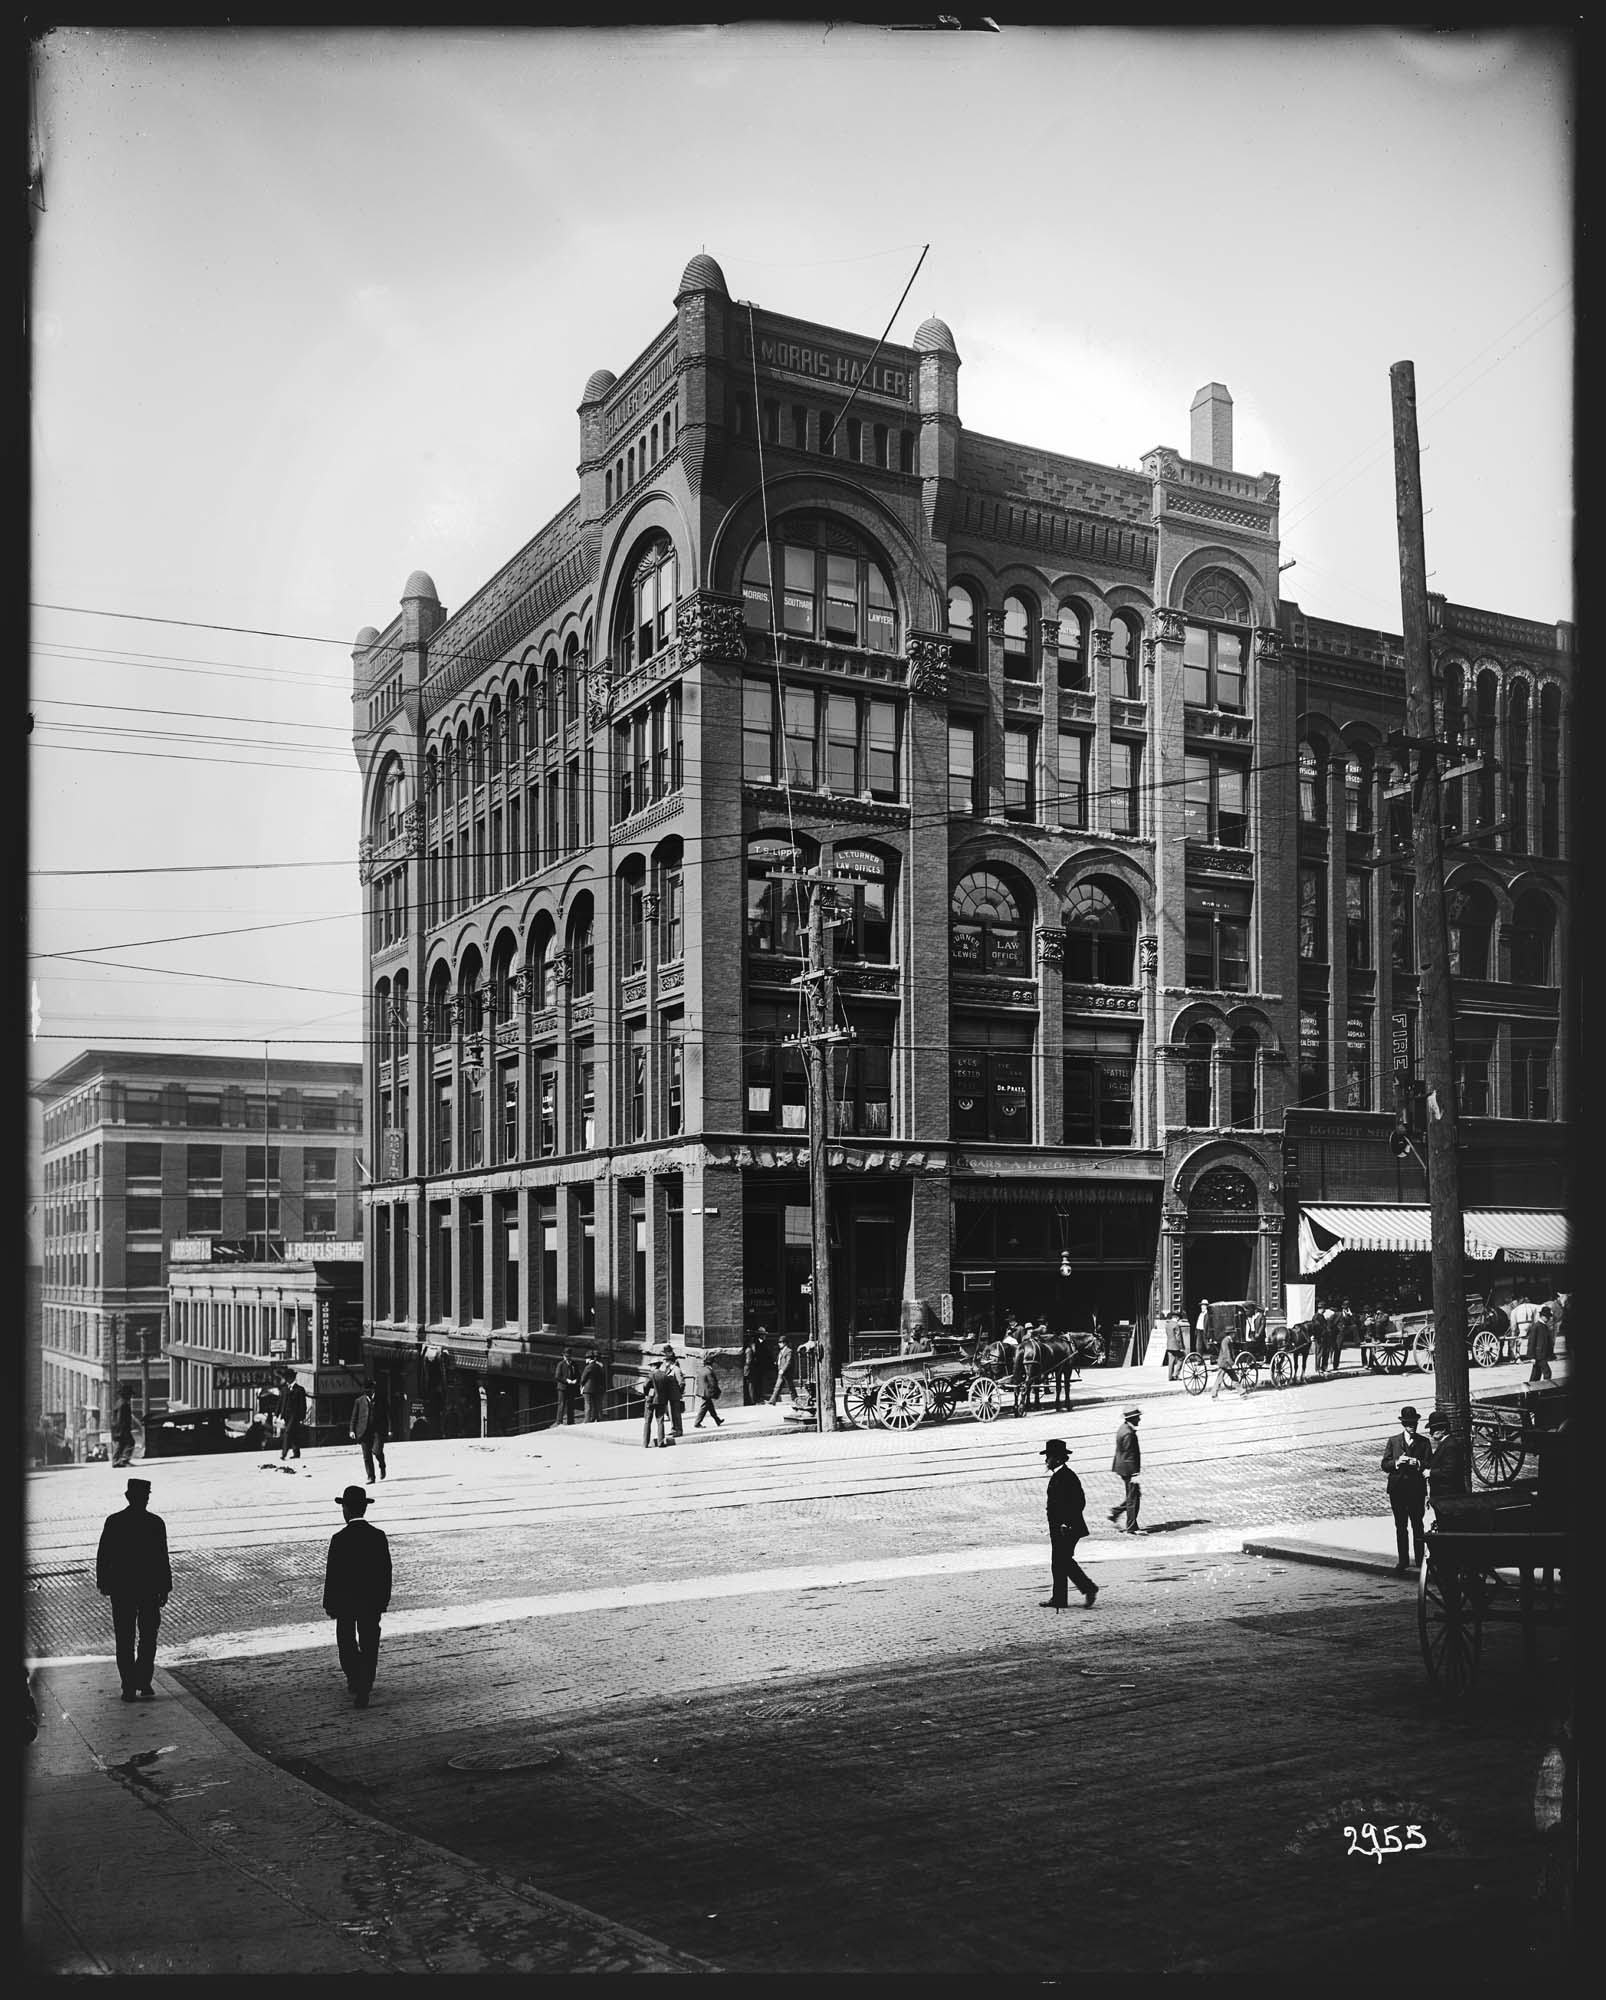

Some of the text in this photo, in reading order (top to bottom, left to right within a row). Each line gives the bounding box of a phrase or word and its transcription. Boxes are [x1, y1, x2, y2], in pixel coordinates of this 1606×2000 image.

[761, 340, 831, 379] MORRIS
[836, 357, 906, 398] HALLER
[608, 391, 640, 441] HALLER
[836, 862, 881, 875] LAW OFFICES
[952, 933, 980, 948] URNER
[997, 941, 1019, 950] LAW
[952, 950, 977, 959] LEWIS
[1392, 1013, 1408, 1071] FIRE
[956, 1158, 1003, 1170] CIGARS
